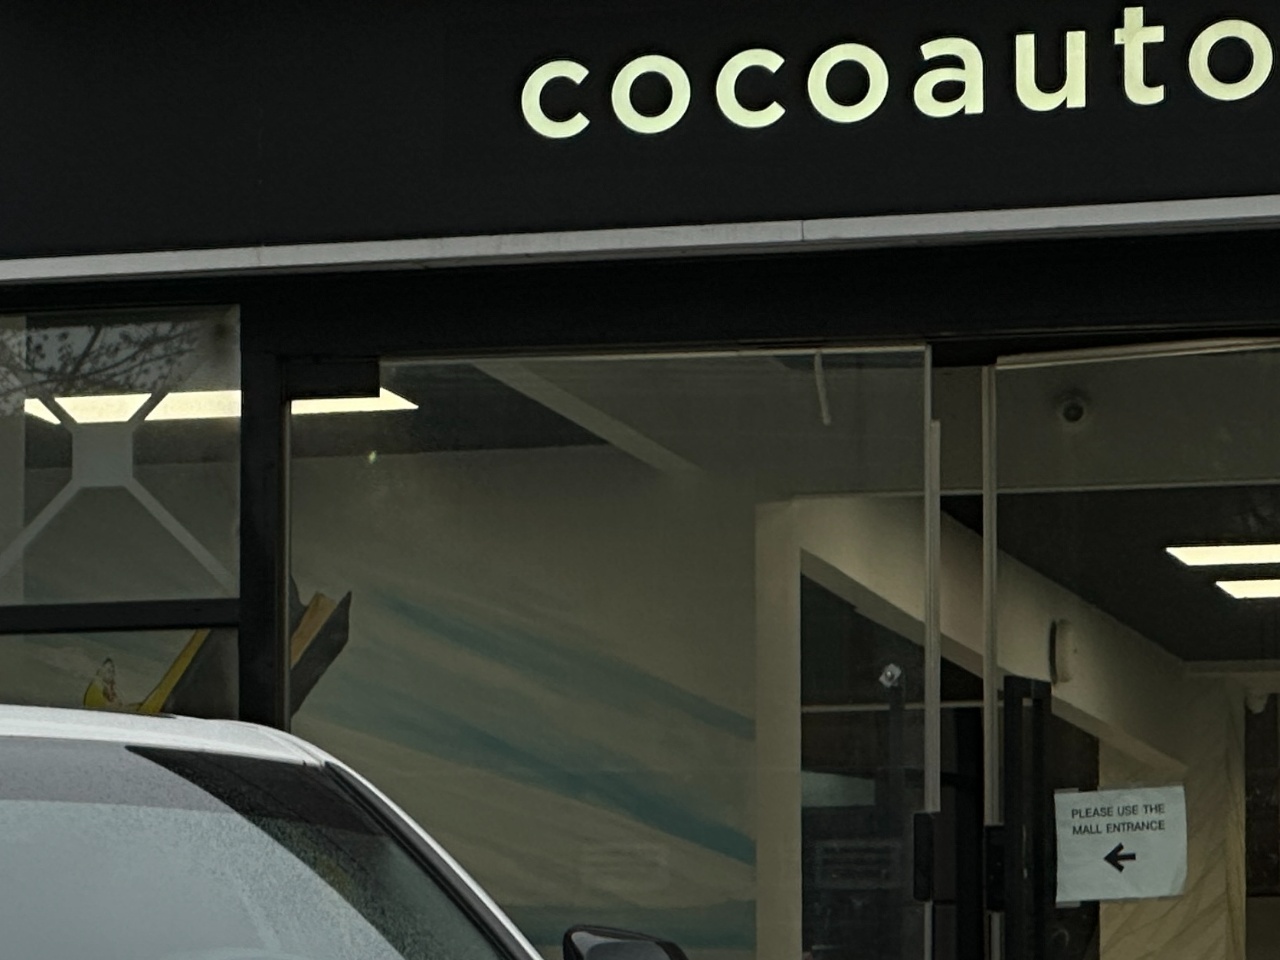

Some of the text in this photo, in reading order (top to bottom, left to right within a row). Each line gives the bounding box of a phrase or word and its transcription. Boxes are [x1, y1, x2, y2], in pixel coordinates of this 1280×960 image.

[521, 6, 1274, 139] cocoauto
[1071, 803, 1165, 819] PLEASE USE THE
[1072, 820, 1165, 835] MALL ENTRANCE
